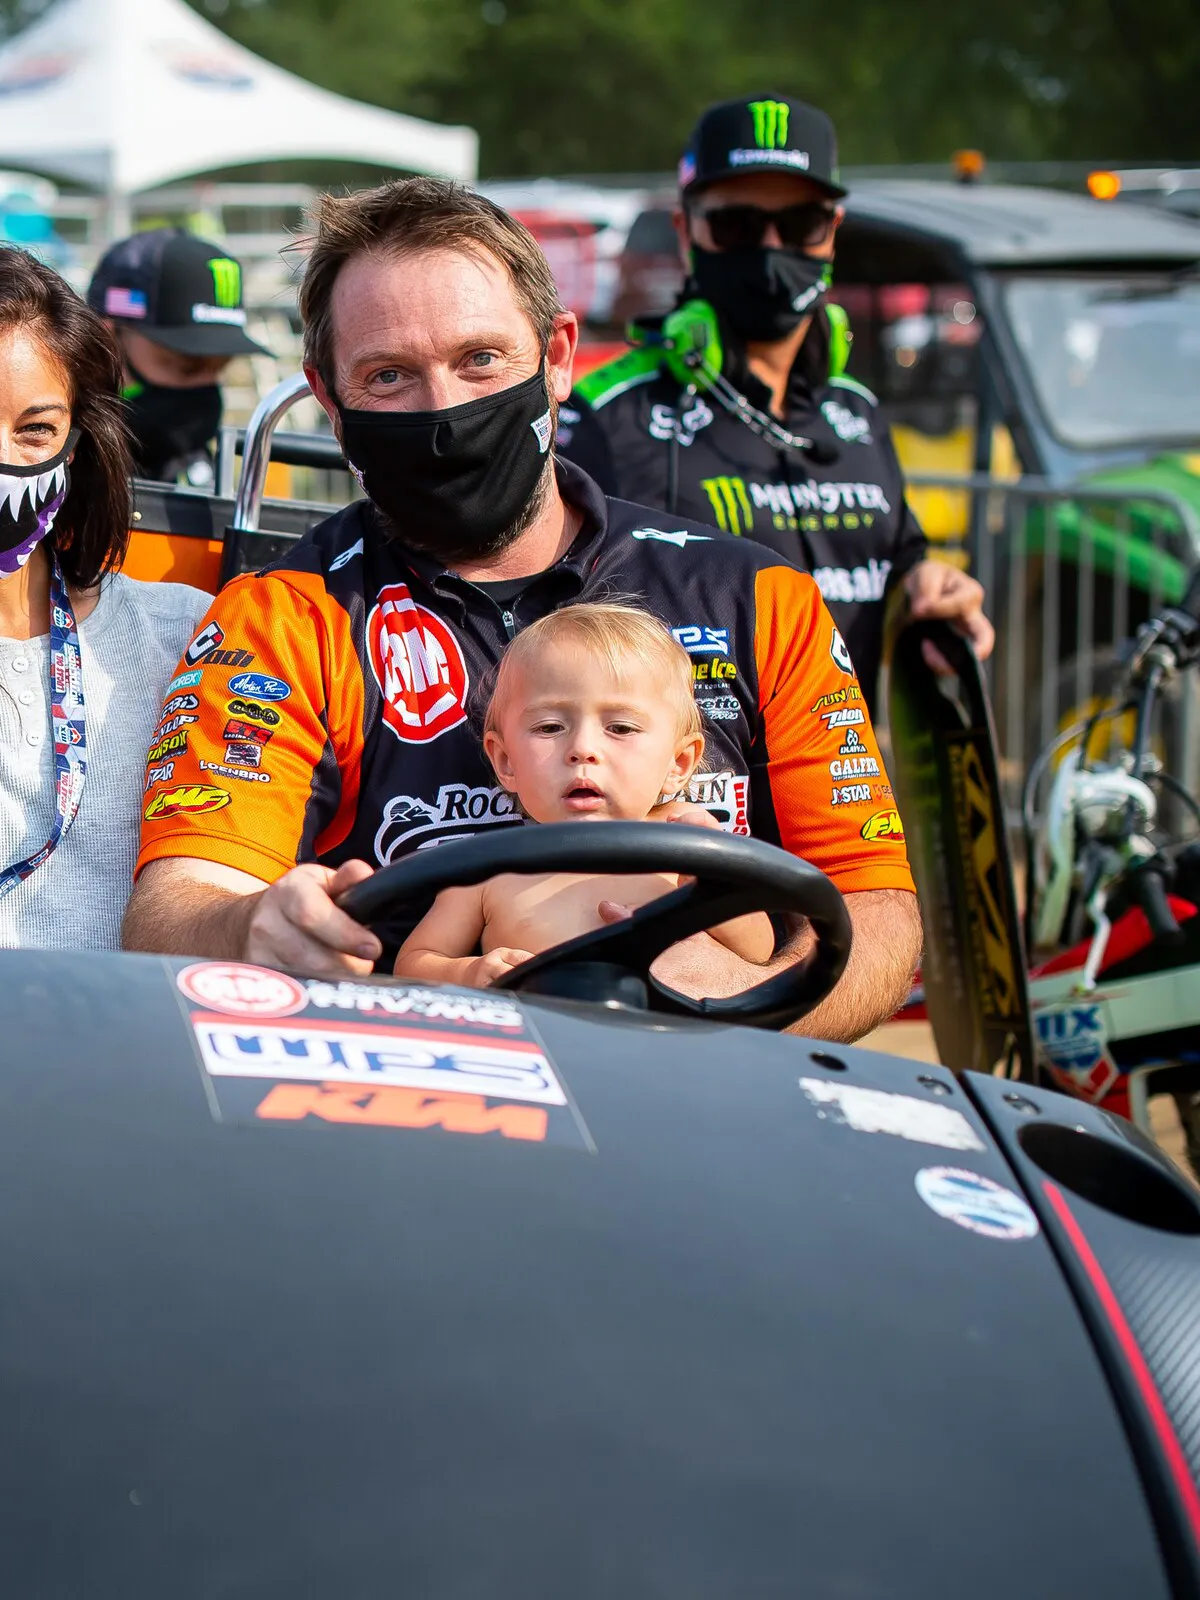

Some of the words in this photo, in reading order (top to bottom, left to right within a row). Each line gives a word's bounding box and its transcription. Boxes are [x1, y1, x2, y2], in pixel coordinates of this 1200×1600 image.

[55, 654, 64, 667] OIL
[55, 666, 65, 691] LUCAS
[234, 675, 261, 693] Motion
[227, 720, 274, 745] ETS
[200, 760, 271, 783] LOENBRO
[830, 757, 879, 778] GALFER
[145, 787, 230, 813] FMF
[440, 789, 518, 821] ROC
[864, 813, 904, 838] FM
[255, 1080, 548, 1142] KTM
